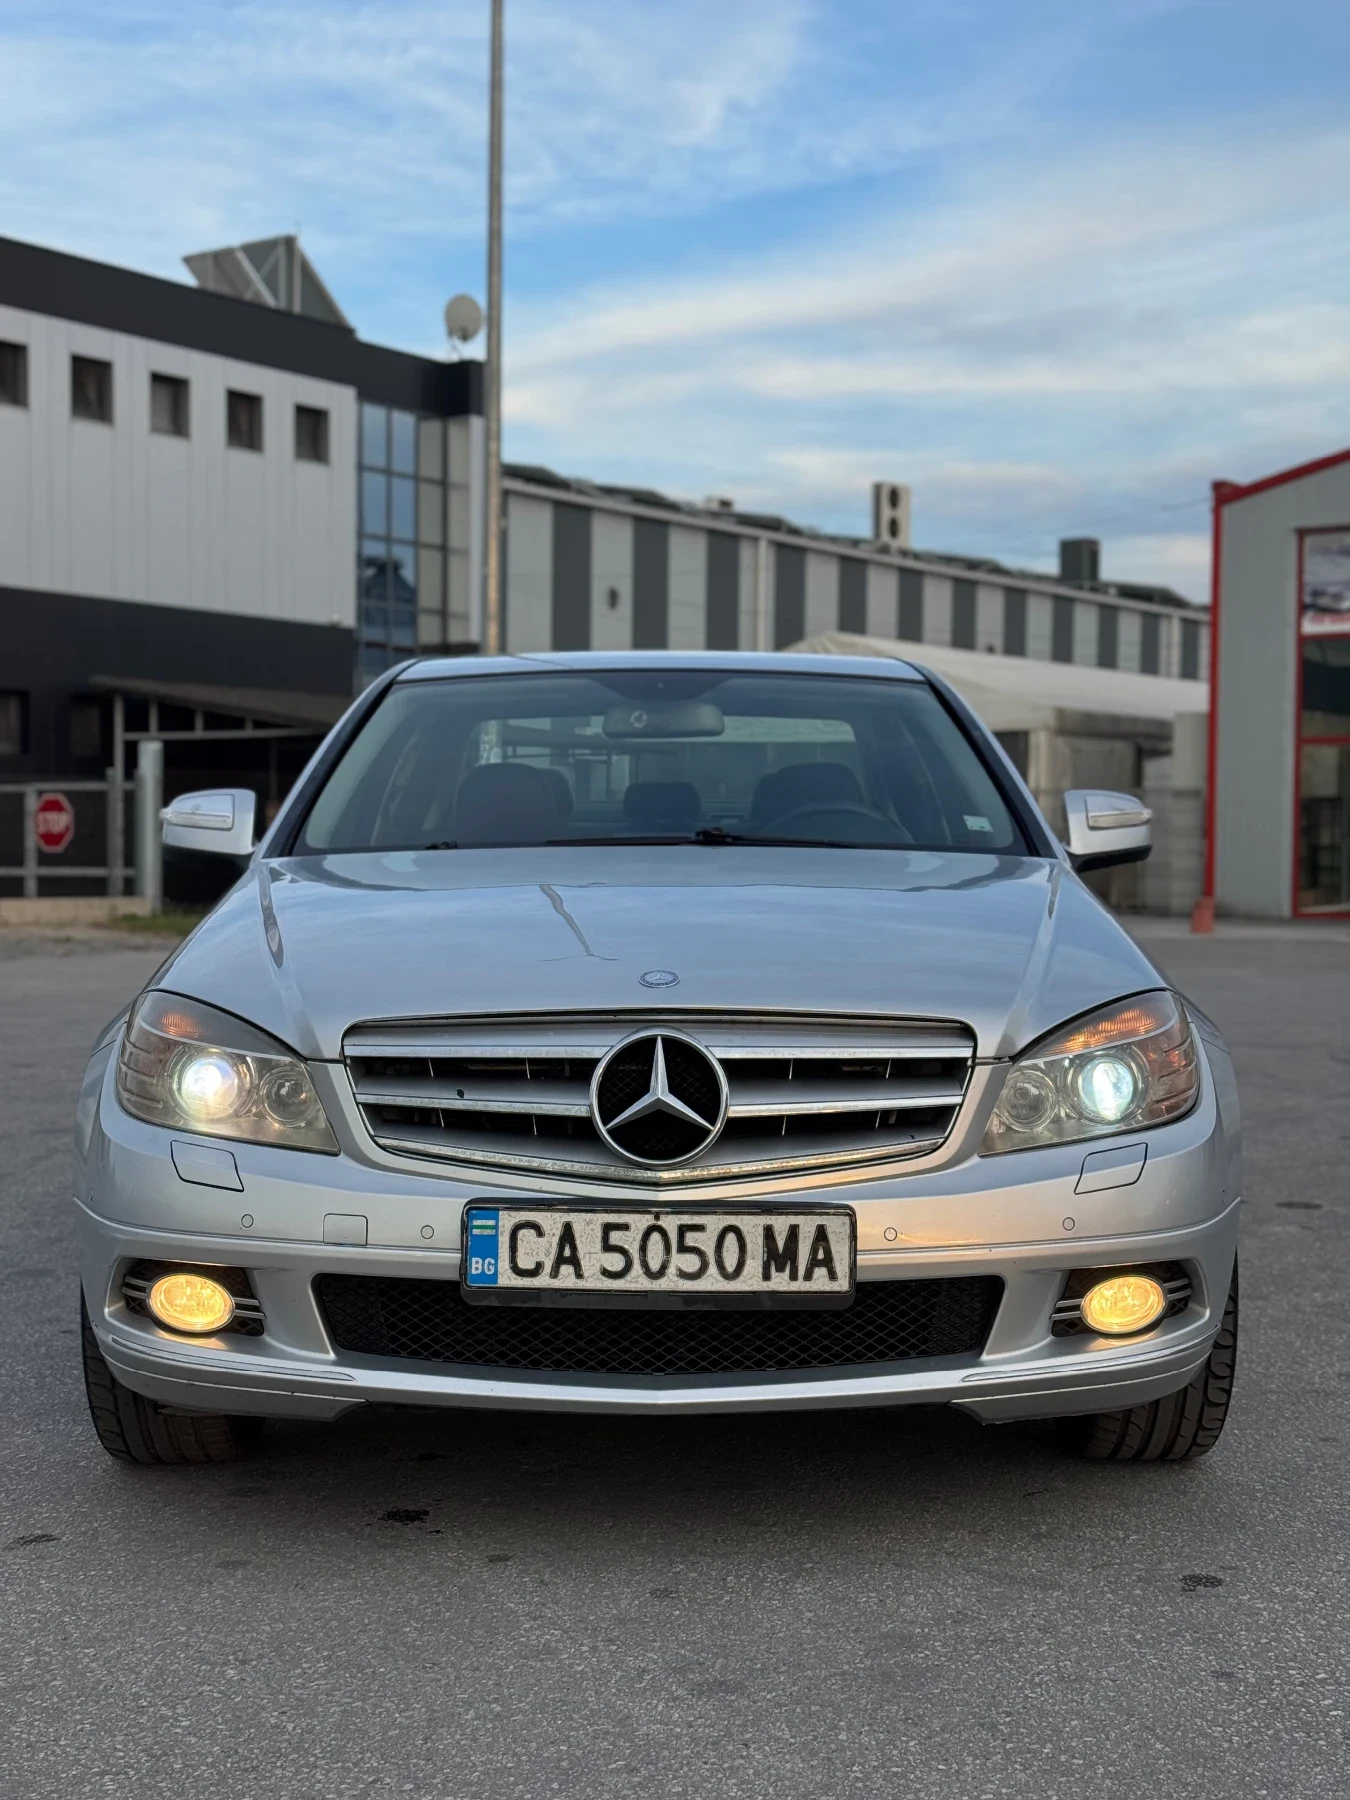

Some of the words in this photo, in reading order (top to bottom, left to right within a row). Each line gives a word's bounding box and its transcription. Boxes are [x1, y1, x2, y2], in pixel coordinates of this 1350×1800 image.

[36, 810, 71, 835] STOP
[508, 1219, 584, 1279] CA
[599, 1222, 748, 1281] 5050
[761, 1223, 839, 1281] MA
[470, 1257, 496, 1275] BG
